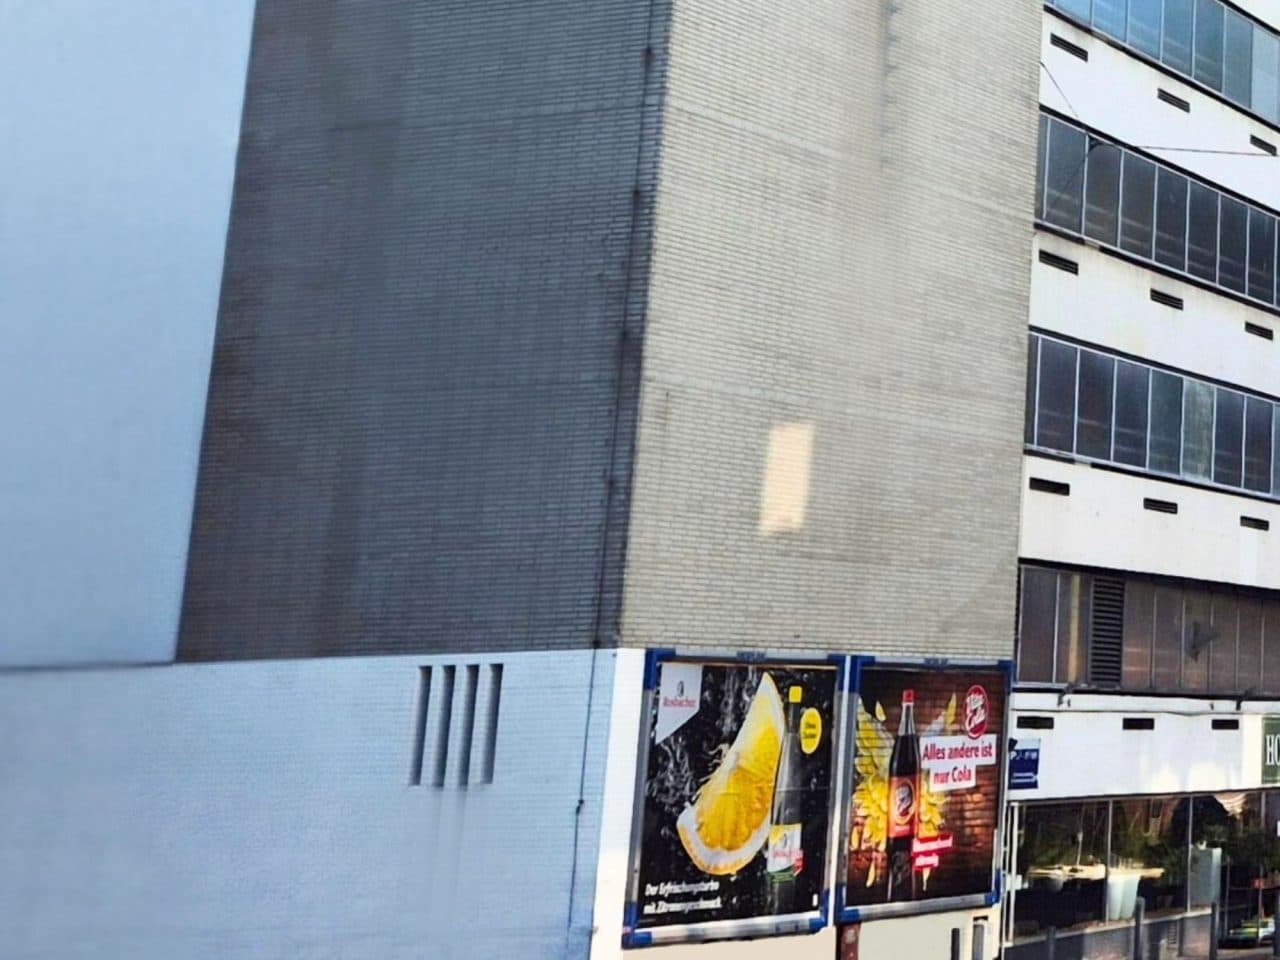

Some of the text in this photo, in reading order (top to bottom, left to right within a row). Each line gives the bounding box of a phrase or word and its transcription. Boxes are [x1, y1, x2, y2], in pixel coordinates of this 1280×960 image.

[922, 740, 993, 761] Alles andere ist
[933, 765, 972, 785] nur Cola
